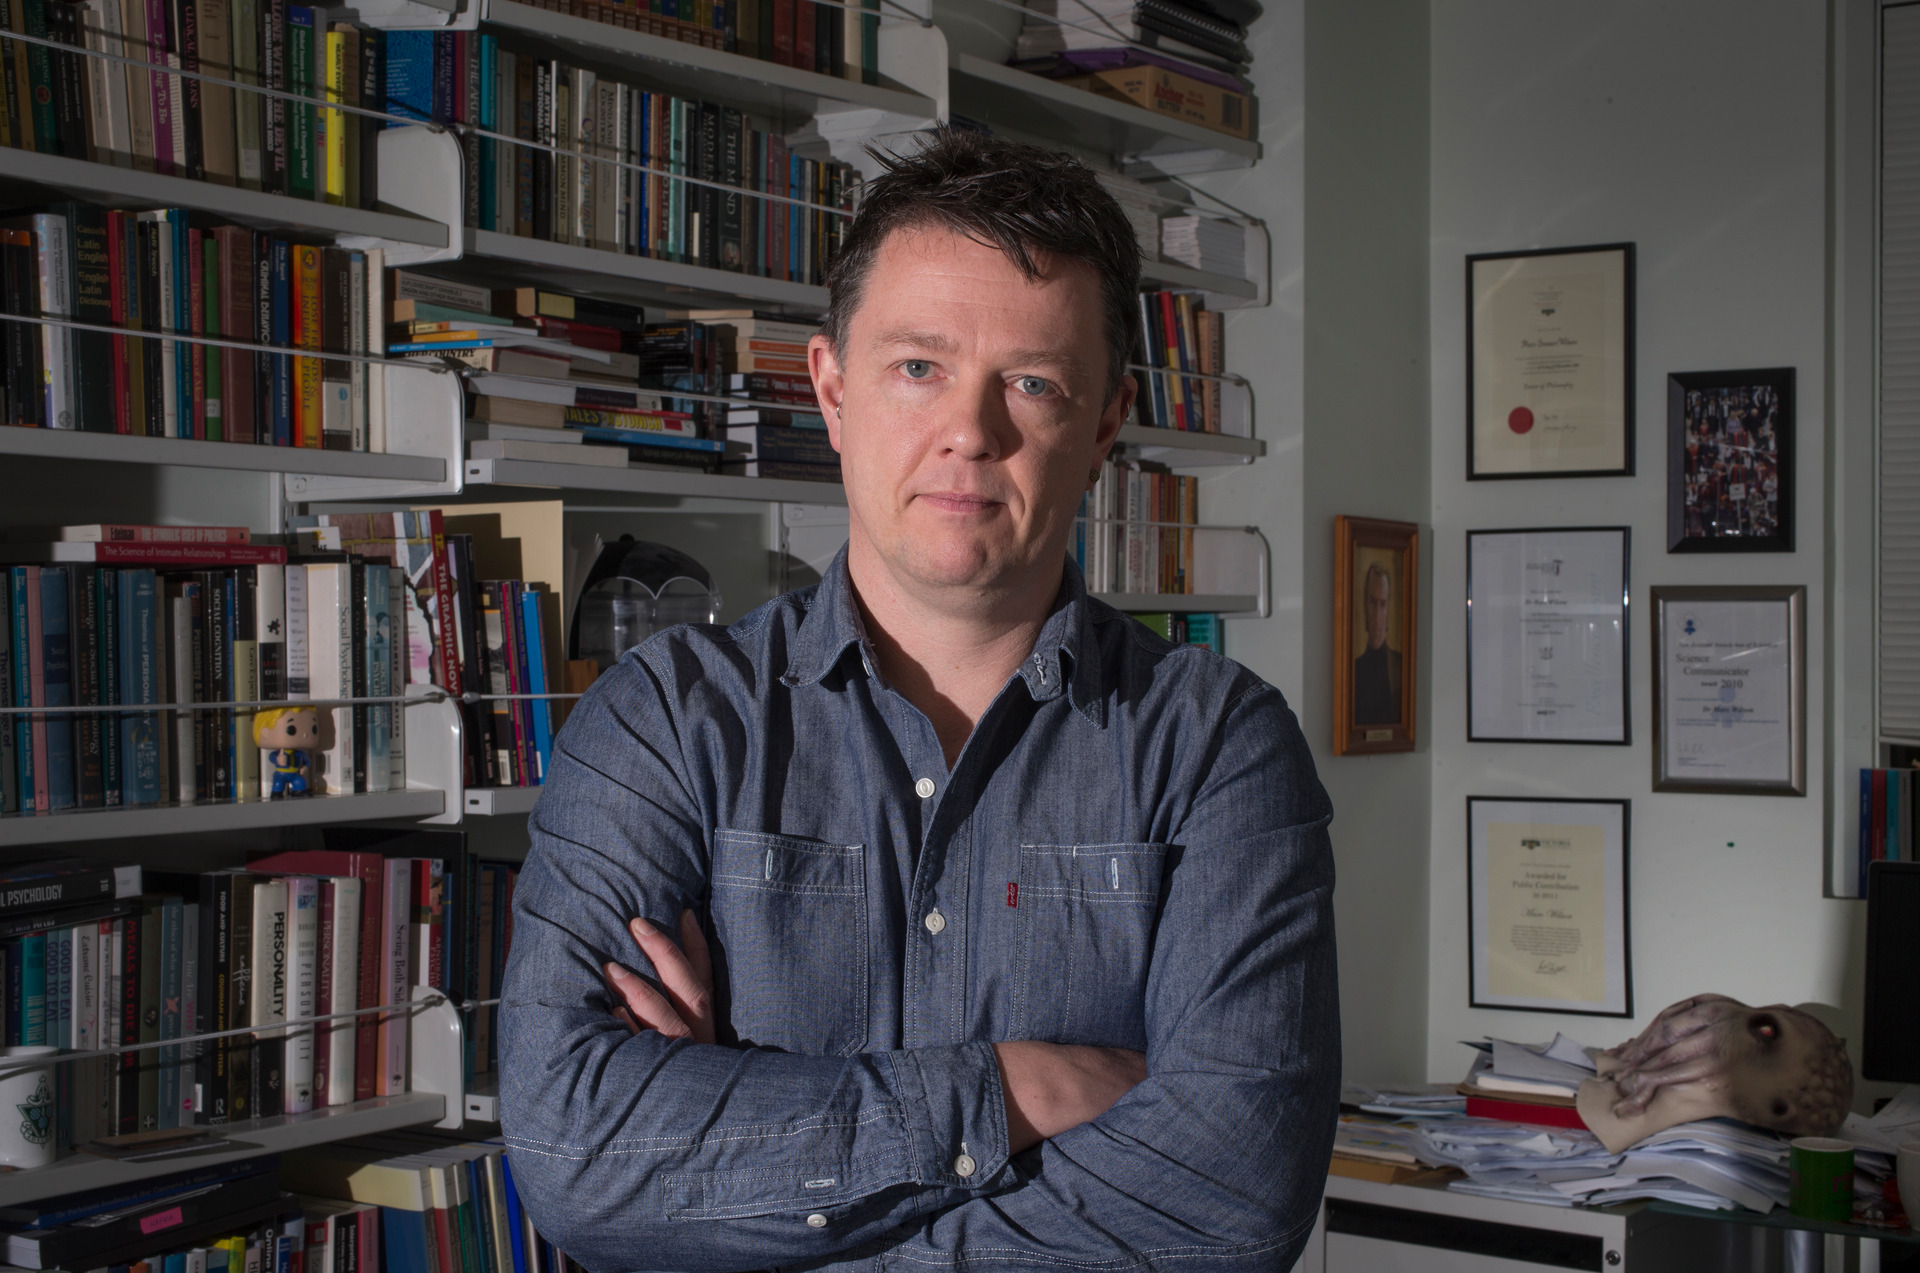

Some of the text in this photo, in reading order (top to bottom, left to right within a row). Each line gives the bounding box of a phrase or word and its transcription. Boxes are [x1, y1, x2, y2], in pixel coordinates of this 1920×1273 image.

[185, 6, 198, 109] CLINICAL HYNOSIS
[272, 45, 284, 88] WITH
[157, 90, 168, 124] To Be
[274, 93, 284, 123] THE
[537, 65, 545, 145] IRRATIONALITY
[599, 88, 607, 144] COGNITION
[1157, 99, 1181, 114] BUTTER
[266, 130, 274, 151] BOSCO
[317, 105, 325, 147] IMAGINE
[469, 57, 479, 216] THE ART REASONING
[544, 127, 551, 142] OF
[274, 126, 286, 171] DEVIL
[706, 112, 715, 183] MODERN
[726, 132, 737, 215] THE MND
[76, 238, 101, 249] Latin
[77, 250, 109, 264] English
[78, 271, 109, 285] English
[150, 251, 158, 277] Speech
[260, 260, 270, 298] CRIMINAL
[278, 262, 286, 280] Spot
[78, 284, 102, 295] Latin
[353, 286, 361, 310] Survey
[192, 282, 202, 401] The Sexual of Meat
[311, 295, 320, 397] LOSE &
[303, 365, 311, 411] PEOPLE
[564, 408, 663, 432] TALES ASTONISH
[104, 546, 117, 557] The
[118, 546, 145, 557] Science
[146, 547, 154, 558] of
[155, 547, 182, 558] Intimate
[183, 547, 226, 560] Relationships
[110, 527, 227, 542] Edelman THE SYMBOLIC USES OF POLITICS
[341, 606, 351, 639] Social
[438, 563, 454, 657] THE GRAPHIC
[86, 575, 98, 685] Readings in Social
[142, 644, 149, 653] of
[213, 588, 223, 680] SOCIAL COGNITION
[193, 629, 201, 680] Psychology
[248, 647, 256, 667] Cave
[1675, 653, 1710, 663] Science
[1683, 666, 1750, 677] Communicator
[0, 649, 12, 748] The of
[142, 654, 151, 725] PERSONAITY
[1719, 679, 1743, 689] 2010
[1731, 706, 1754, 714] Wilson
[195, 723, 204, 766] Problems
[7, 884, 63, 906] PSYCHOLOGY
[1511, 880, 1579, 891] Public Contribution
[1524, 872, 1566, 881] Awarded for
[171, 941, 177, 951] of
[273, 911, 285, 1016] PERSONALITY
[321, 919, 332, 1000] PERSONALITY
[394, 924, 406, 983] Seeing Both
[47, 941, 58, 1022] GOOD TO EAT
[60, 940, 71, 1021] GOOD TO EAT
[81, 936, 93, 1008] Extreme Cuisine
[126, 919, 137, 1031] MEALS TO DIE
[169, 972, 175, 982] we
[232, 954, 252, 1006] caffeine
[186, 960, 195, 1031] You Are WHY
[167, 1014, 176, 1033] peter
[264, 1228, 274, 1268] Online
